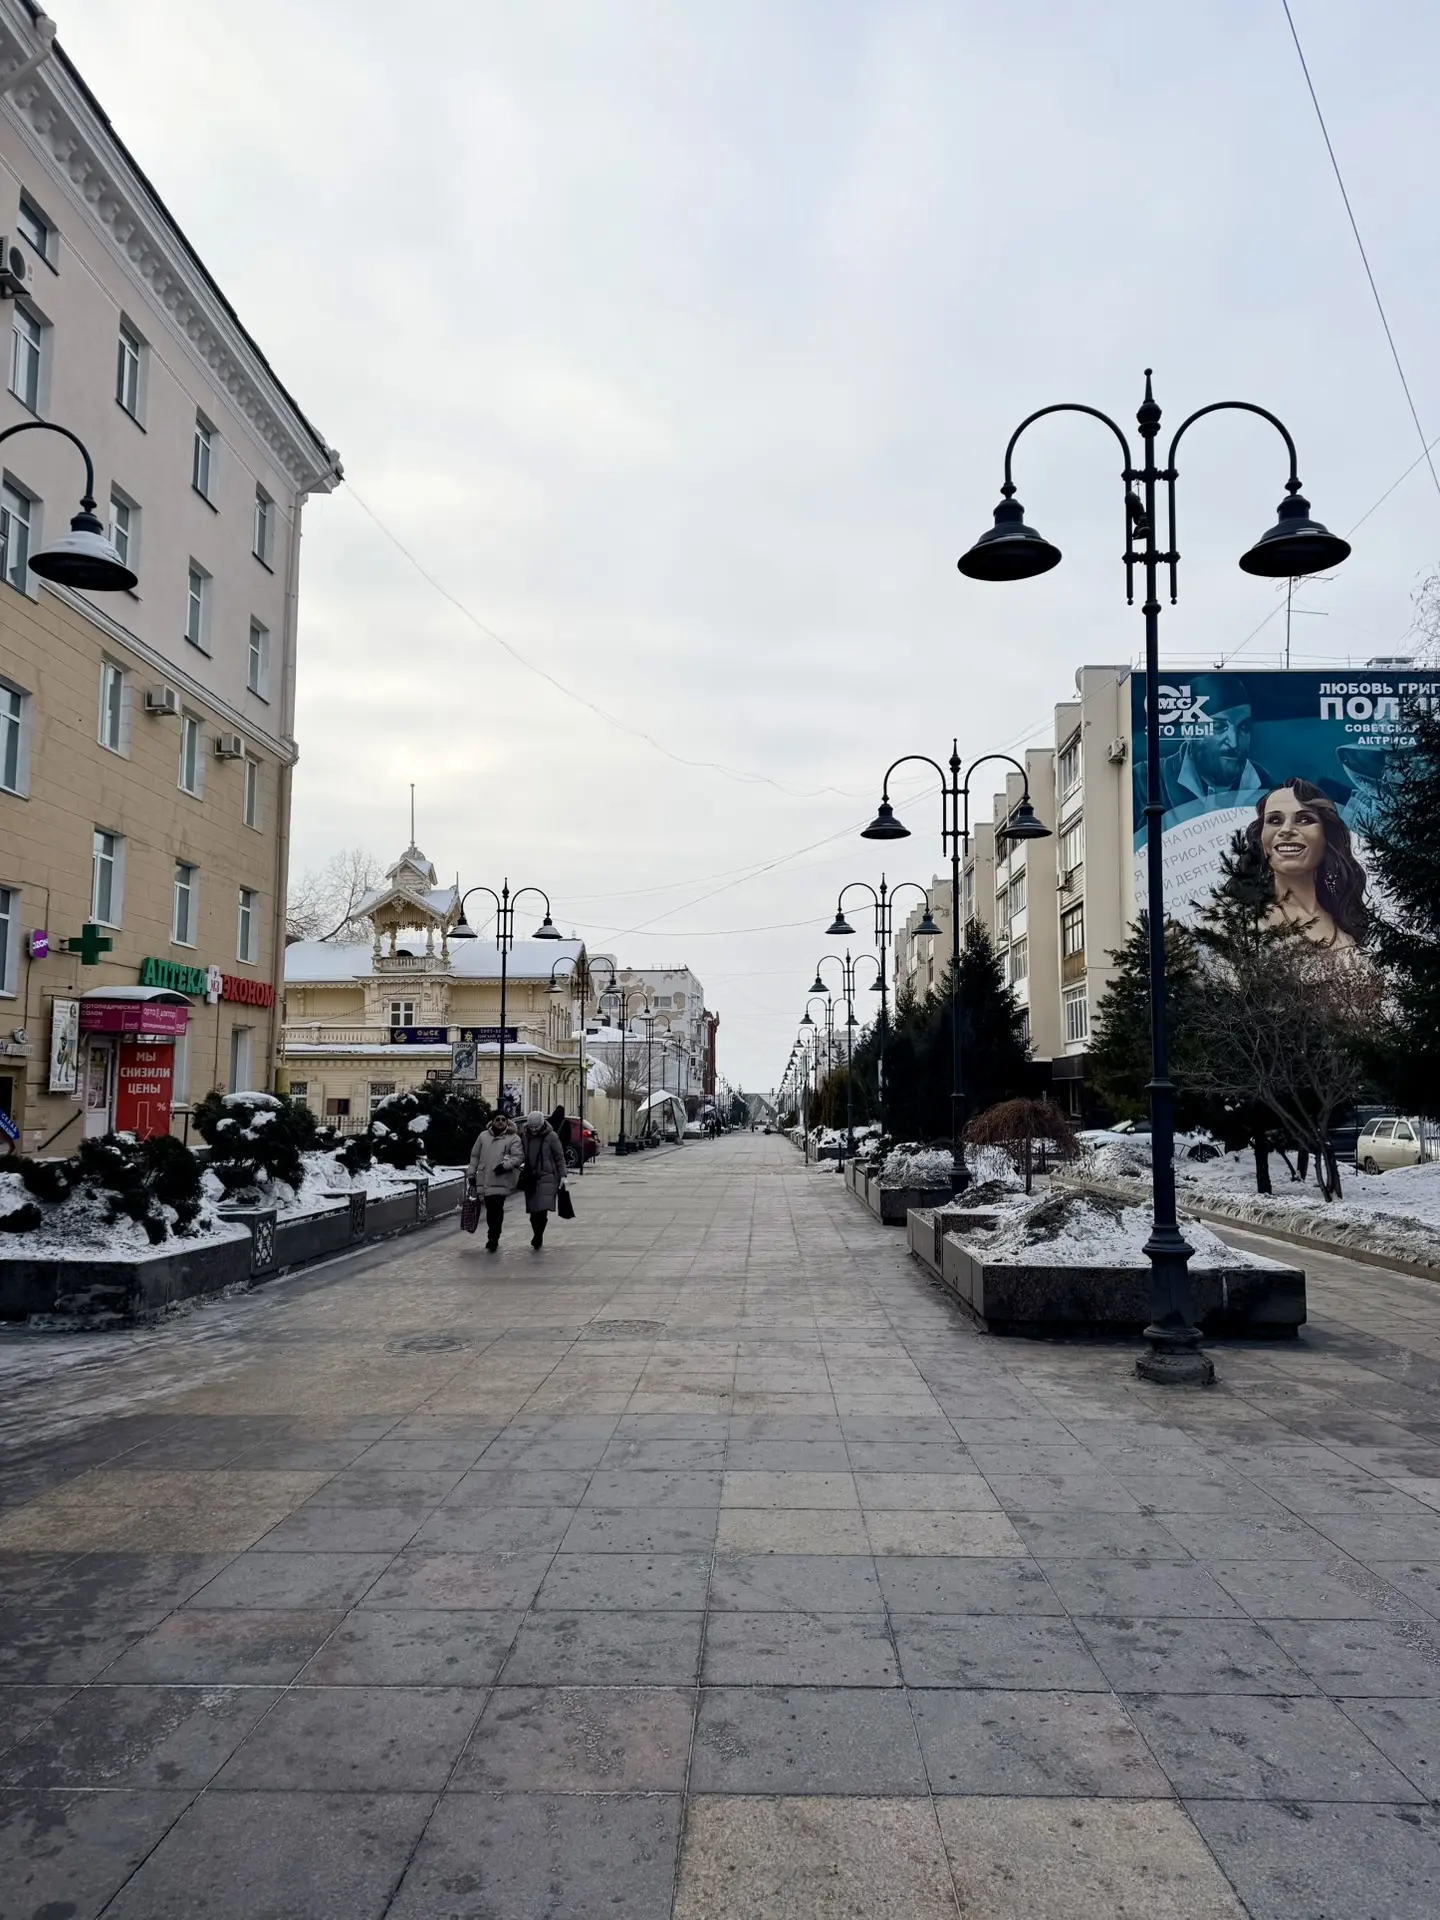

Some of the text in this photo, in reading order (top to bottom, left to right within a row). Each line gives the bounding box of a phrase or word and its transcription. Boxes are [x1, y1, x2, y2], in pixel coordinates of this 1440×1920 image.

[1319, 683, 1393, 695] ЛЮБОВЬ
[1181, 723, 1214, 736] МЫ!
[1358, 736, 1417, 745] АКТРИСА
[1183, 806, 1249, 839] ПОЛИЩУК
[143, 958, 275, 1008] АПТЕКА ЭКОНОМ
[136, 1051, 157, 1061] МЫ
[120, 1067, 170, 1078] СНИЗИЛИ
[128, 1083, 161, 1095] ЦЕНЫ
